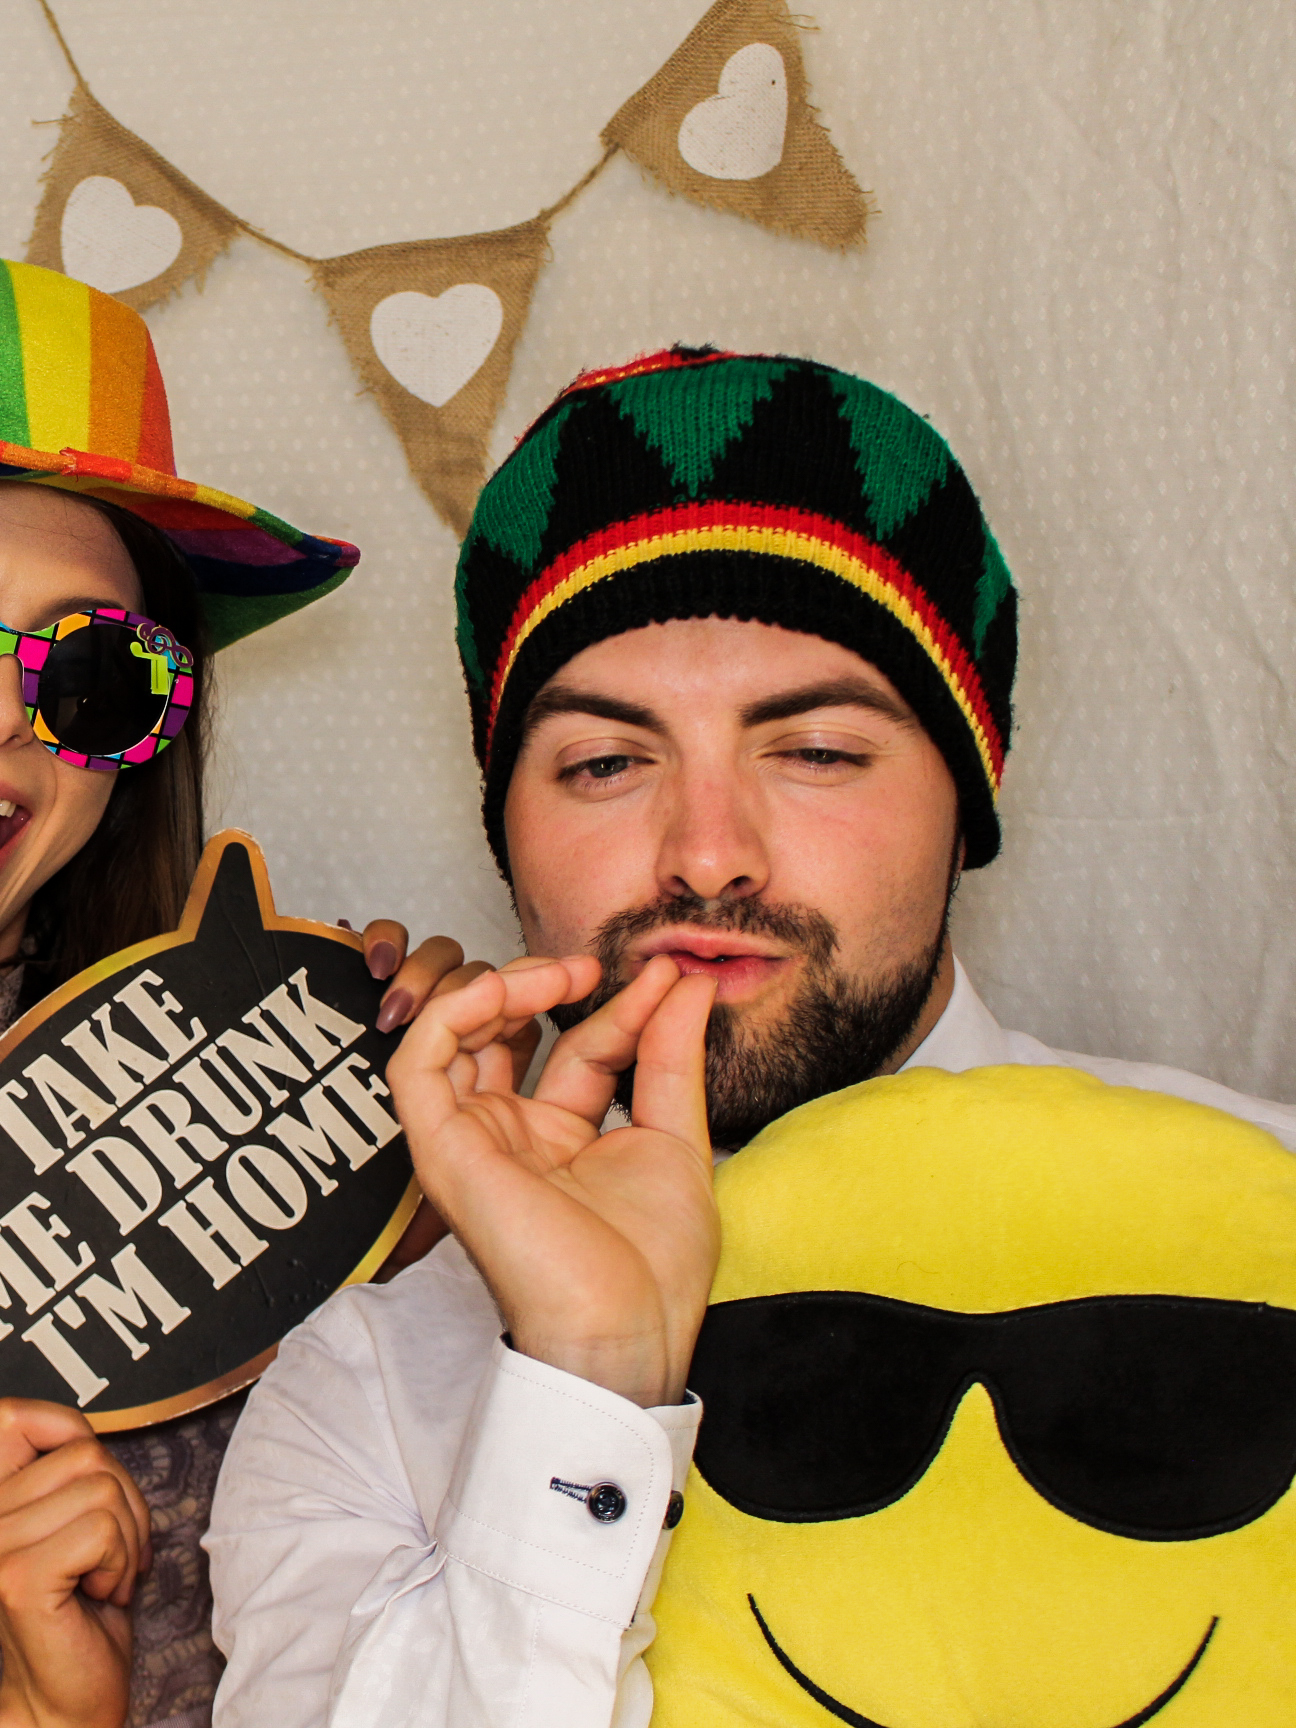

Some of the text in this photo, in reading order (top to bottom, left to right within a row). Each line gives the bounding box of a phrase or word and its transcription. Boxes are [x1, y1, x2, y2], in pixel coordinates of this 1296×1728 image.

[21, 1052, 402, 1407] I'M HOME
[64, 966, 367, 1236] DRUNK
